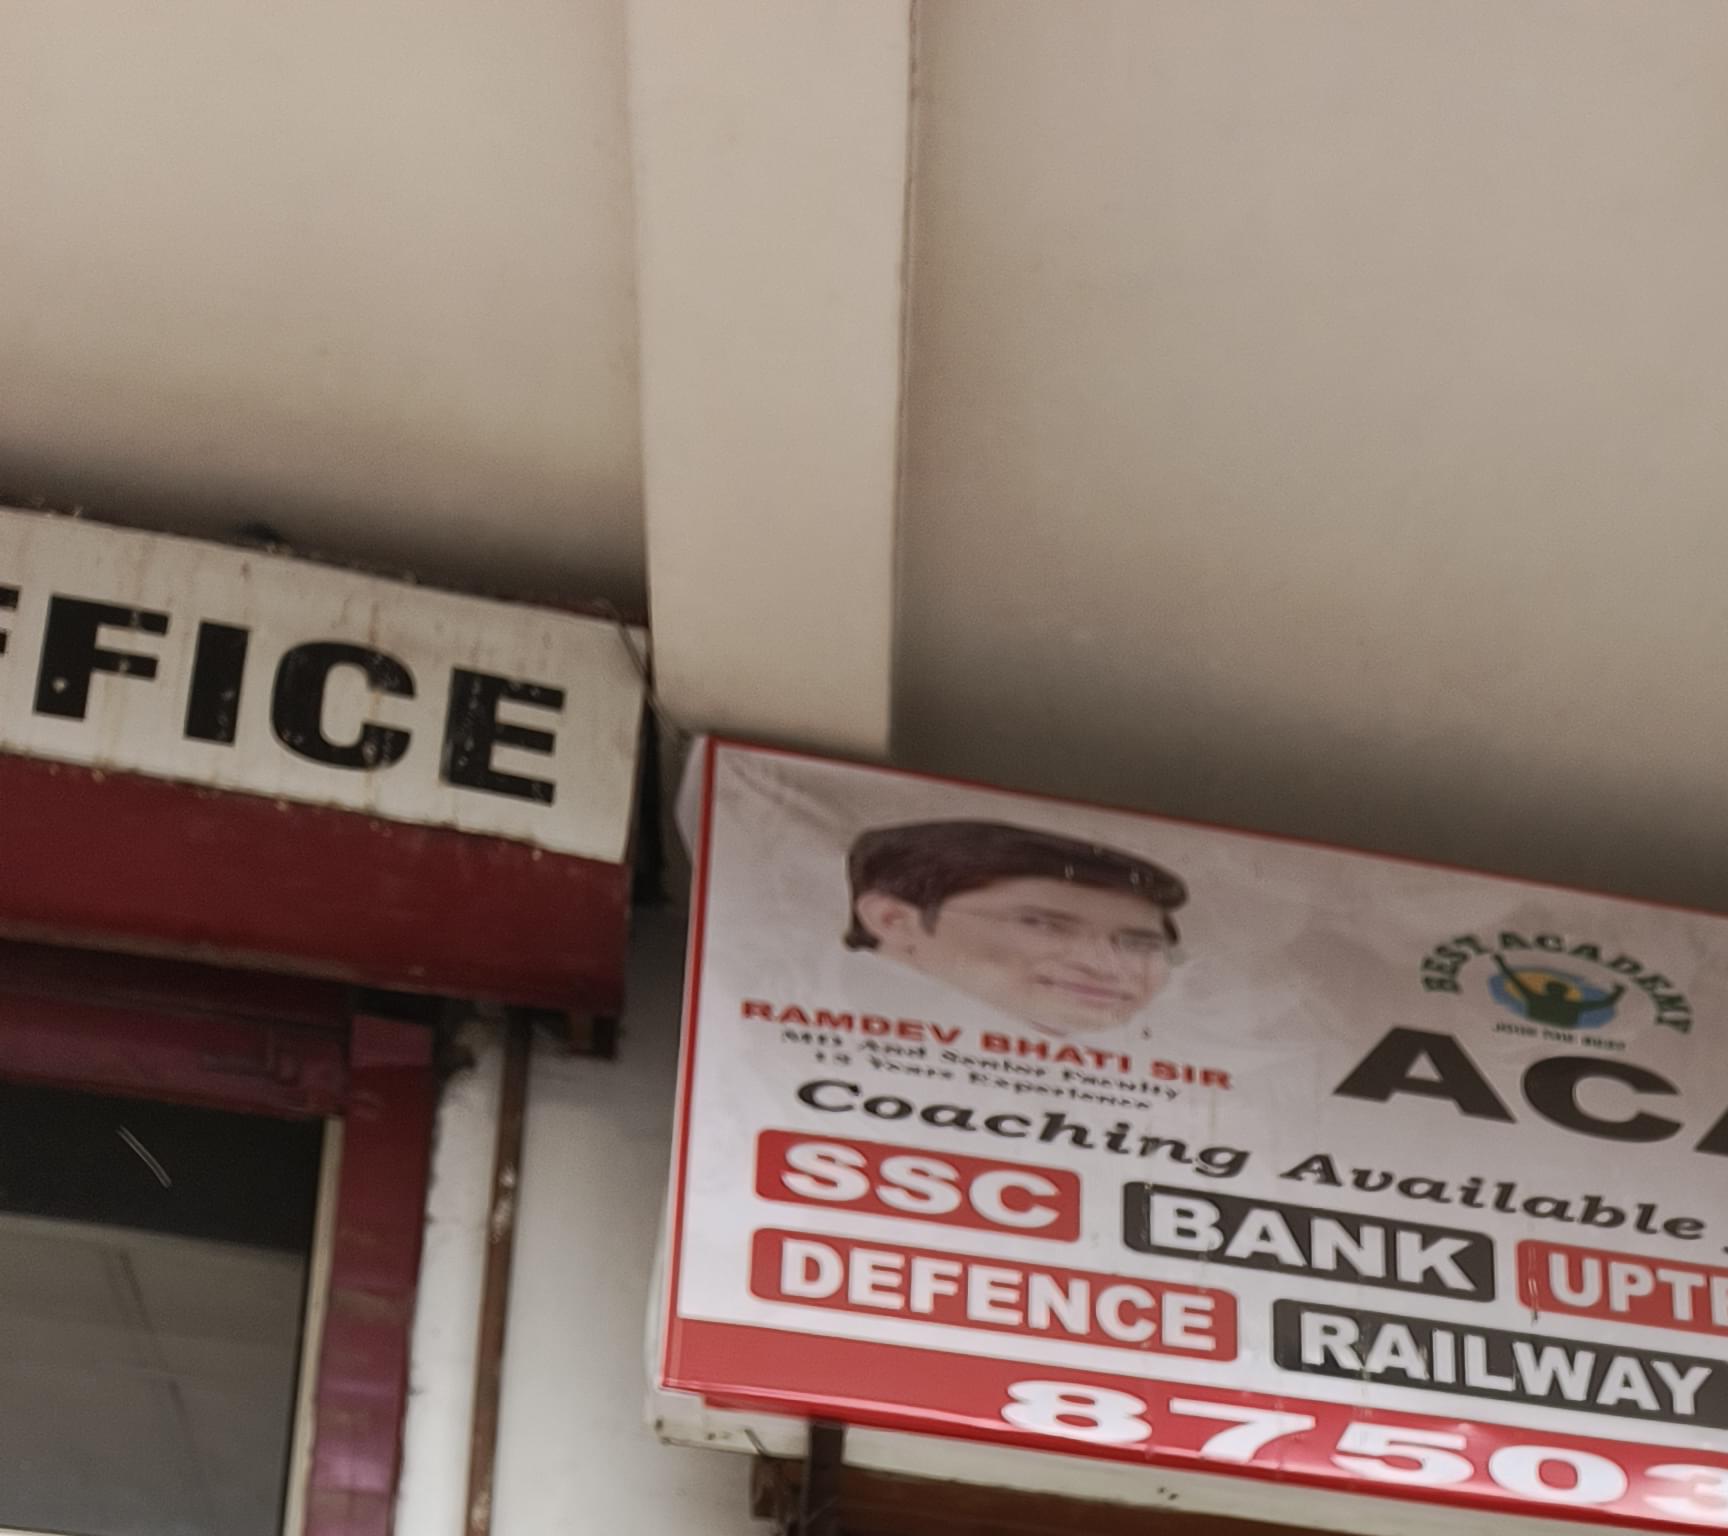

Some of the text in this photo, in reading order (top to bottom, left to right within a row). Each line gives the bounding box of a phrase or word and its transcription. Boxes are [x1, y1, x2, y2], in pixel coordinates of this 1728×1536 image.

[0, 584, 566, 806] FICE
[1420, 930, 1694, 1035] BEST ACADEMY
[740, 999, 1233, 1090] RAMDEV BHATI SIR
[780, 1140, 1062, 1230] SSC
[797, 1079, 1250, 1178] Coaching
[1279, 1152, 1706, 1241] Available
[778, 1236, 1218, 1352] DEFENCE
[1149, 1193, 1478, 1293] BANK
[1300, 1310, 1713, 1417] RAILWAY
